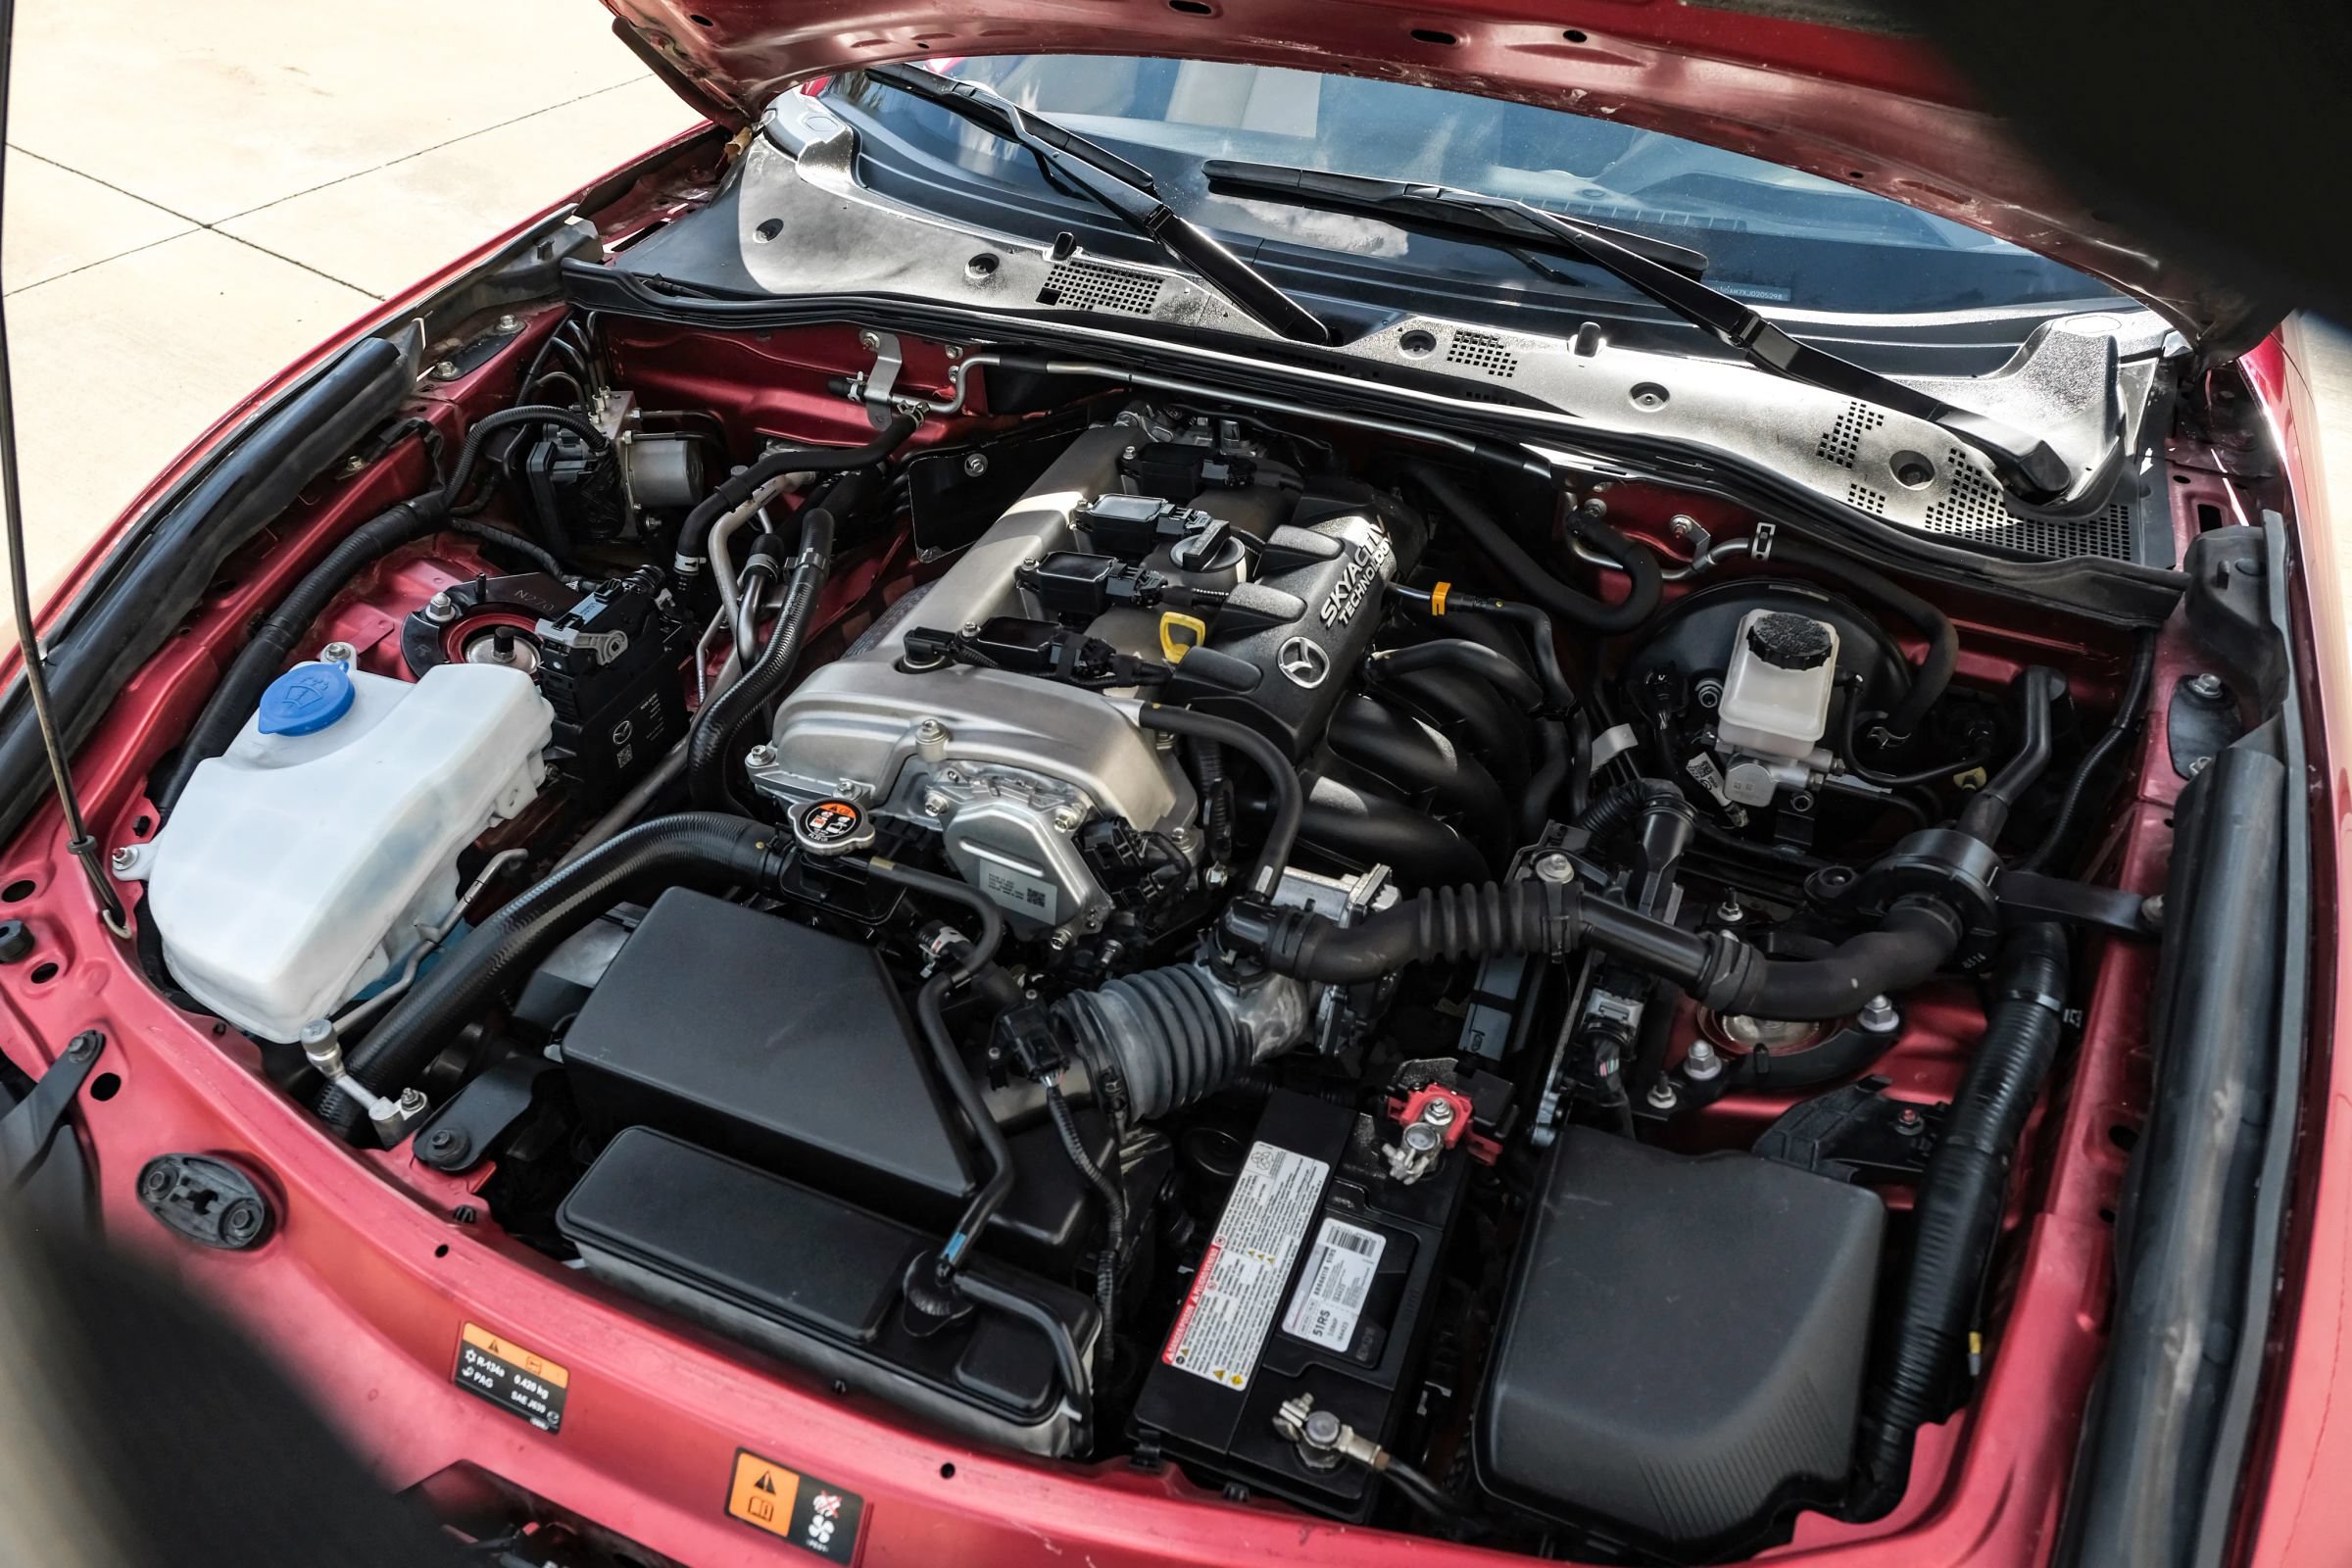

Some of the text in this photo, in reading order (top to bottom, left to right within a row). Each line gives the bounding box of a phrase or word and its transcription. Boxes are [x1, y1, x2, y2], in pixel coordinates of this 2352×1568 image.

[1320, 514, 1385, 630] SKYACTIV
[1338, 532, 1393, 627] TECHNOLOGY
[514, 588, 555, 612] N270
[1313, 1309, 1332, 1338] 51RS
[473, 1370, 494, 1389] PAG
[511, 1391, 528, 1405] SAE
[476, 1355, 506, 1378] R-134a
[537, 1384, 550, 1399] kg
